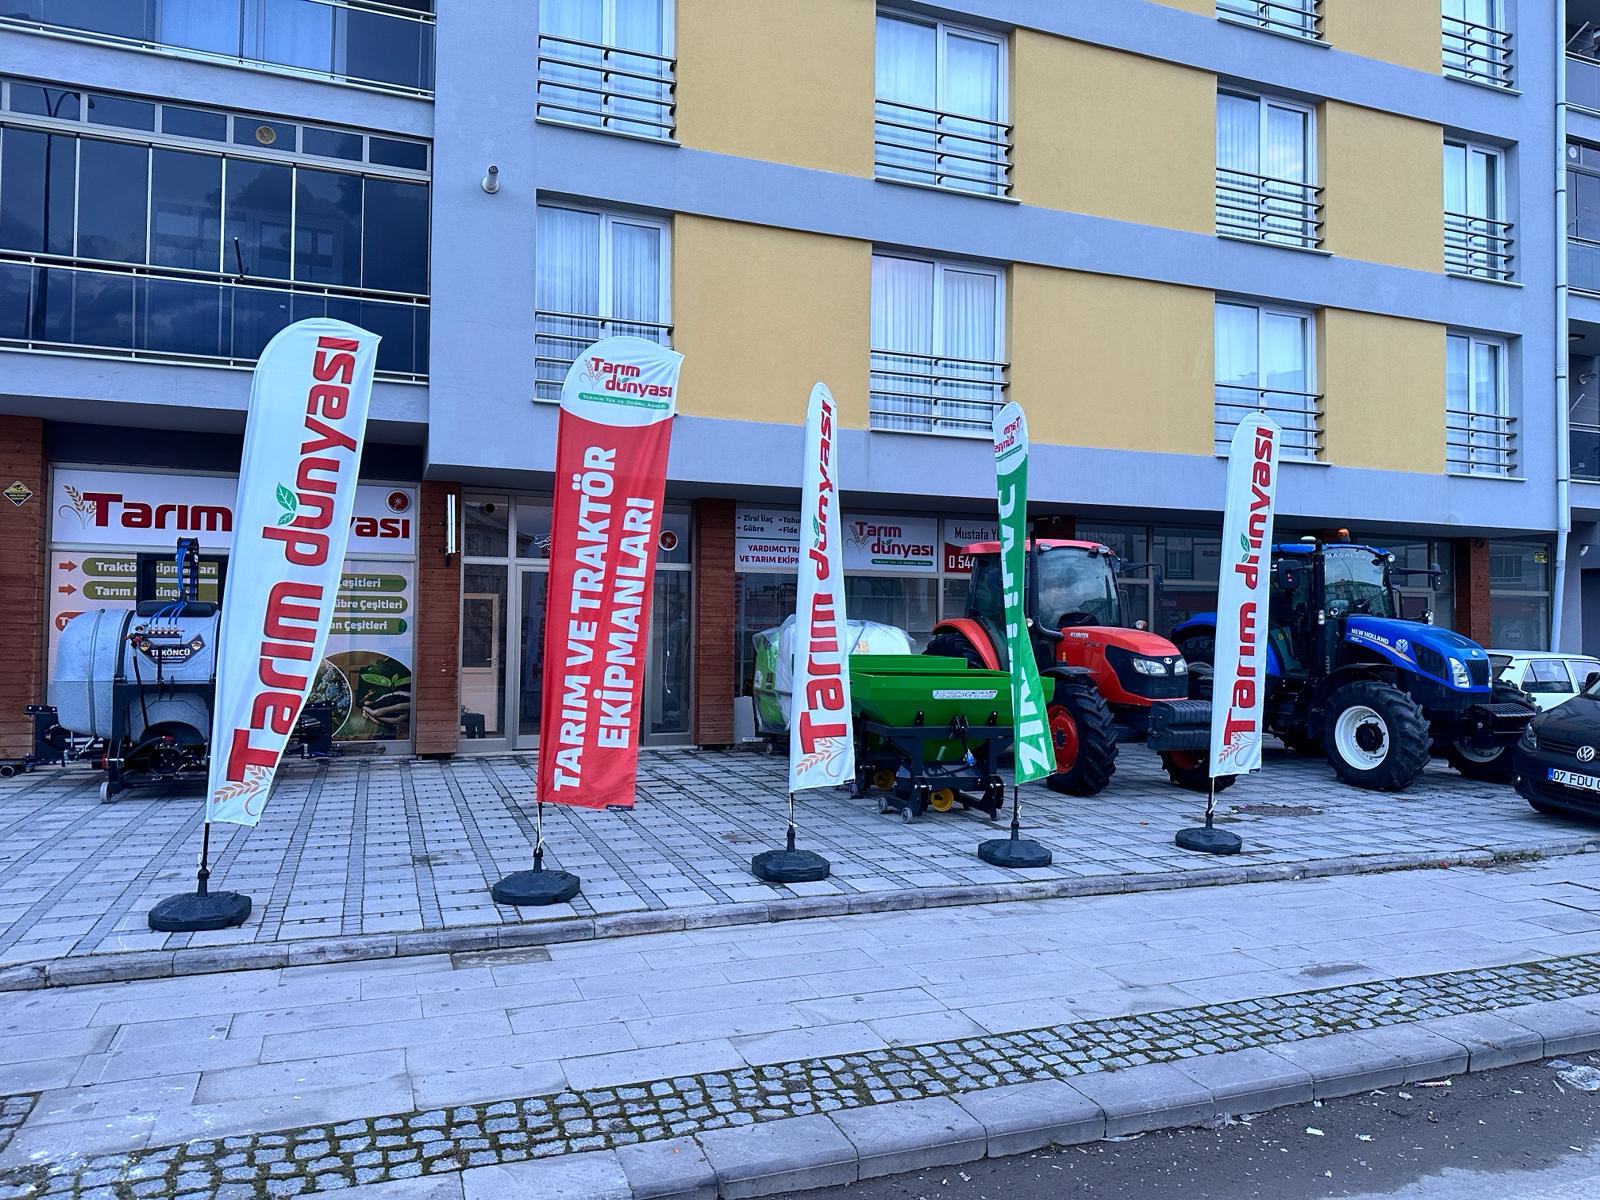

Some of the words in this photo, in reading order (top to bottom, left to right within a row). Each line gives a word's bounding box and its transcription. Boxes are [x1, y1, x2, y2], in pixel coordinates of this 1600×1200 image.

[591, 357, 640, 377] Tarım
[83, 492, 232, 531] Tarım
[570, 446, 617, 614] TRAKTÖR
[783, 526, 798, 534] Fide
[855, 521, 902, 538] Tarım
[954, 526, 989, 540] Mustafa
[748, 544, 786, 553] YARDIMCI
[96, 561, 138, 573] Traktö
[740, 555, 750, 563] VE
[751, 555, 776, 564] TARIM
[95, 586, 131, 597] Tarım
[593, 497, 655, 749] EKİPMANLARI
[566, 620, 598, 667] VE
[226, 581, 323, 783] Tarım
[800, 593, 847, 754] Tarım
[1223, 601, 1256, 745] Tarım
[553, 675, 591, 791] TARIM
[1553, 770, 1566, 782] 07
[1569, 773, 1593, 788] FDU
